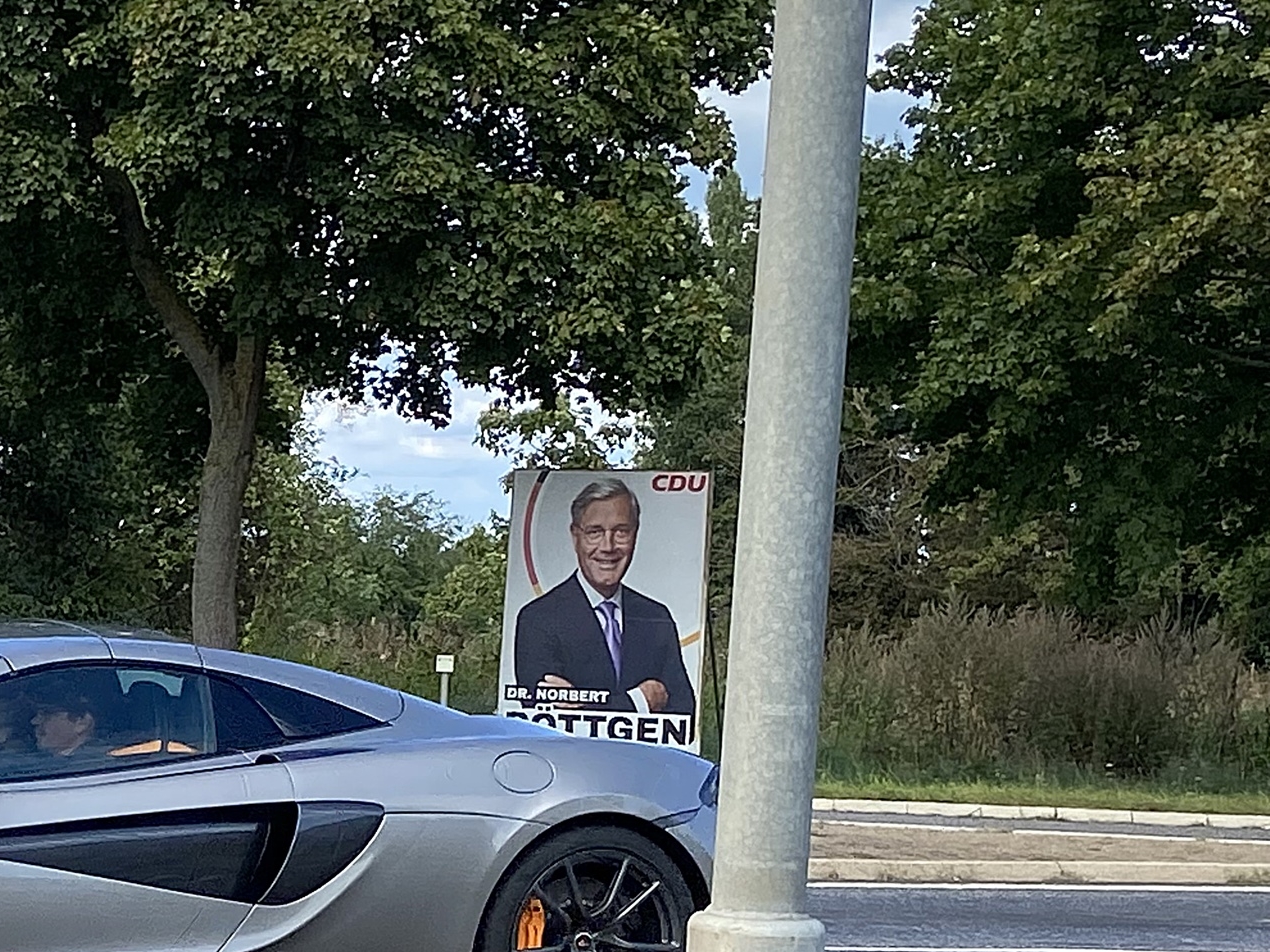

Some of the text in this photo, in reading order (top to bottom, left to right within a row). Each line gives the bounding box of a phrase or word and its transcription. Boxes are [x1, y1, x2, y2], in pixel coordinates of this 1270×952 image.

[652, 474, 707, 492] CDU
[506, 686, 610, 704] DR. NORBERT
[506, 706, 687, 746] ÖTTGEN
